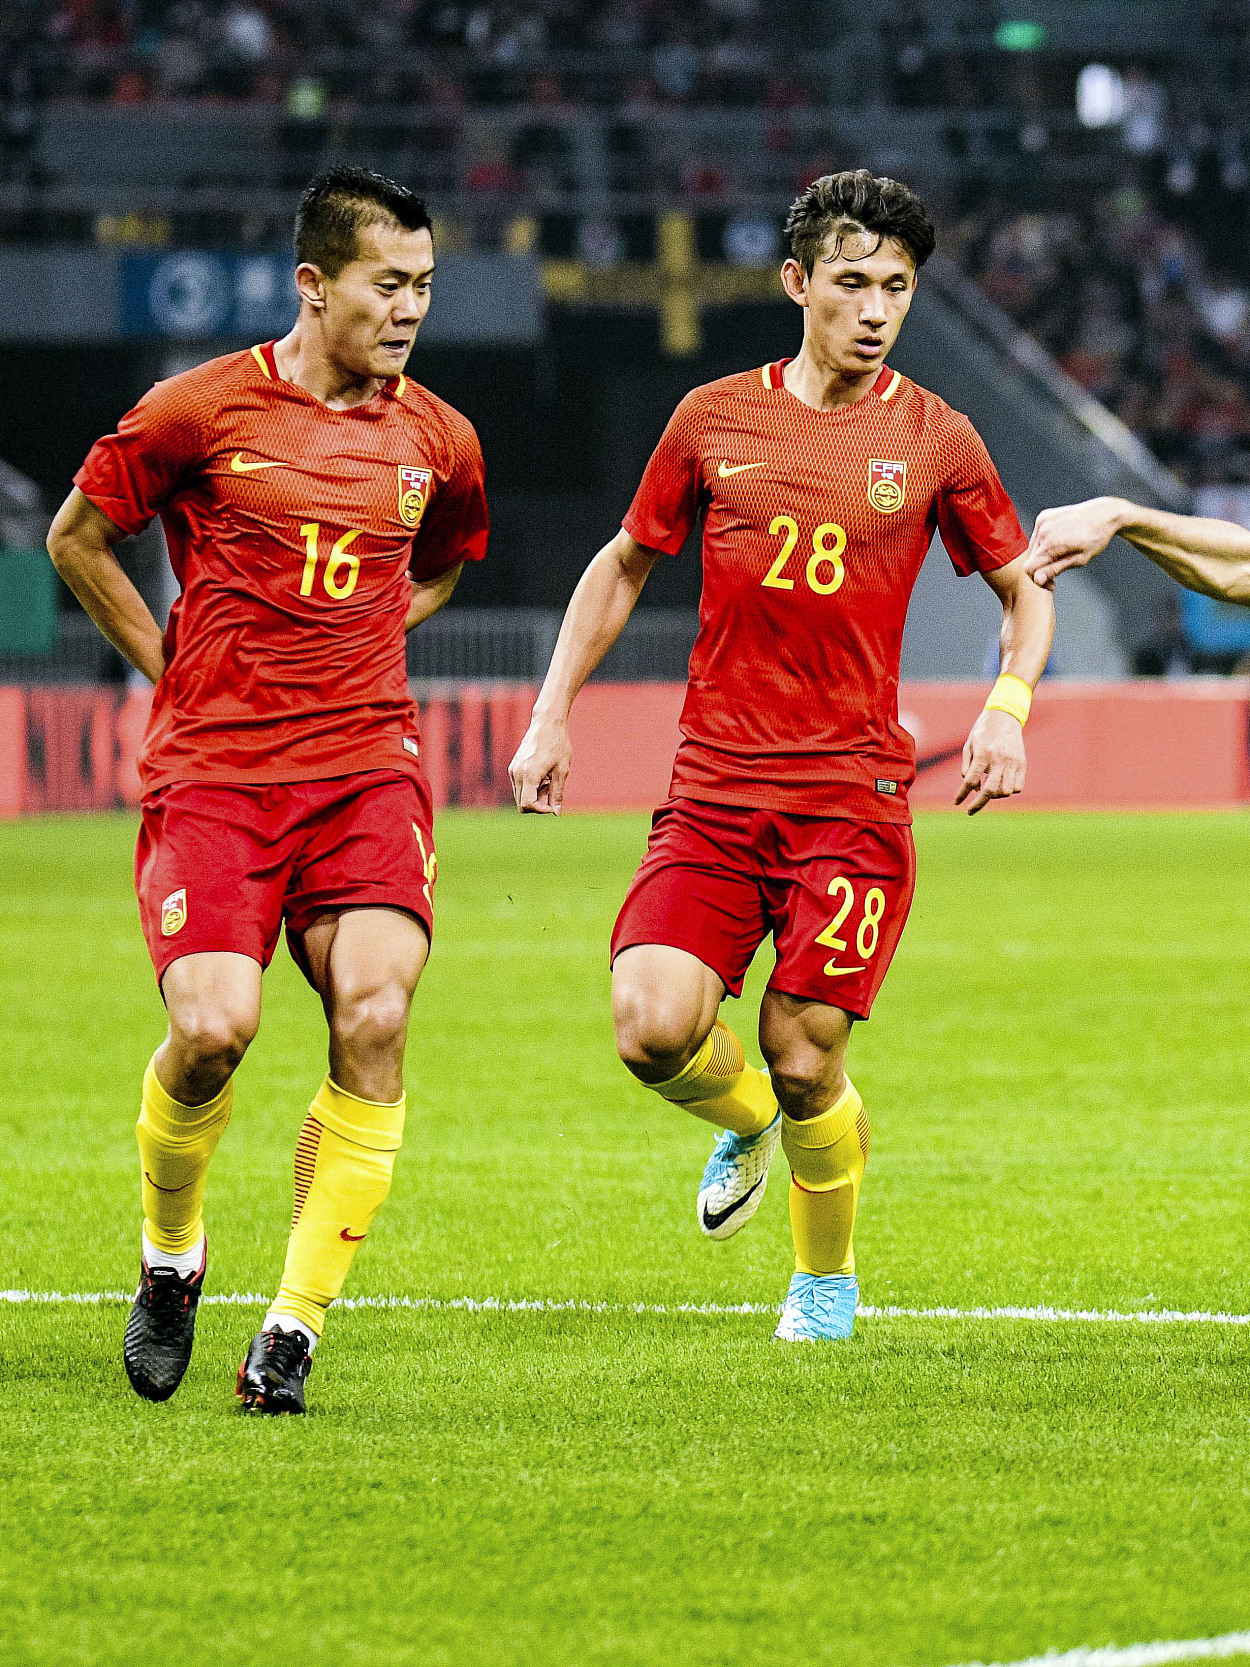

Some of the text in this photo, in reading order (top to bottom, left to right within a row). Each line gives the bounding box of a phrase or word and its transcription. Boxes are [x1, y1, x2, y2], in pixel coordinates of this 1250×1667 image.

[873, 462, 903, 474] CFA
[299, 523, 365, 599] 16
[761, 515, 847, 595] 28
[814, 876, 886, 960] 28
